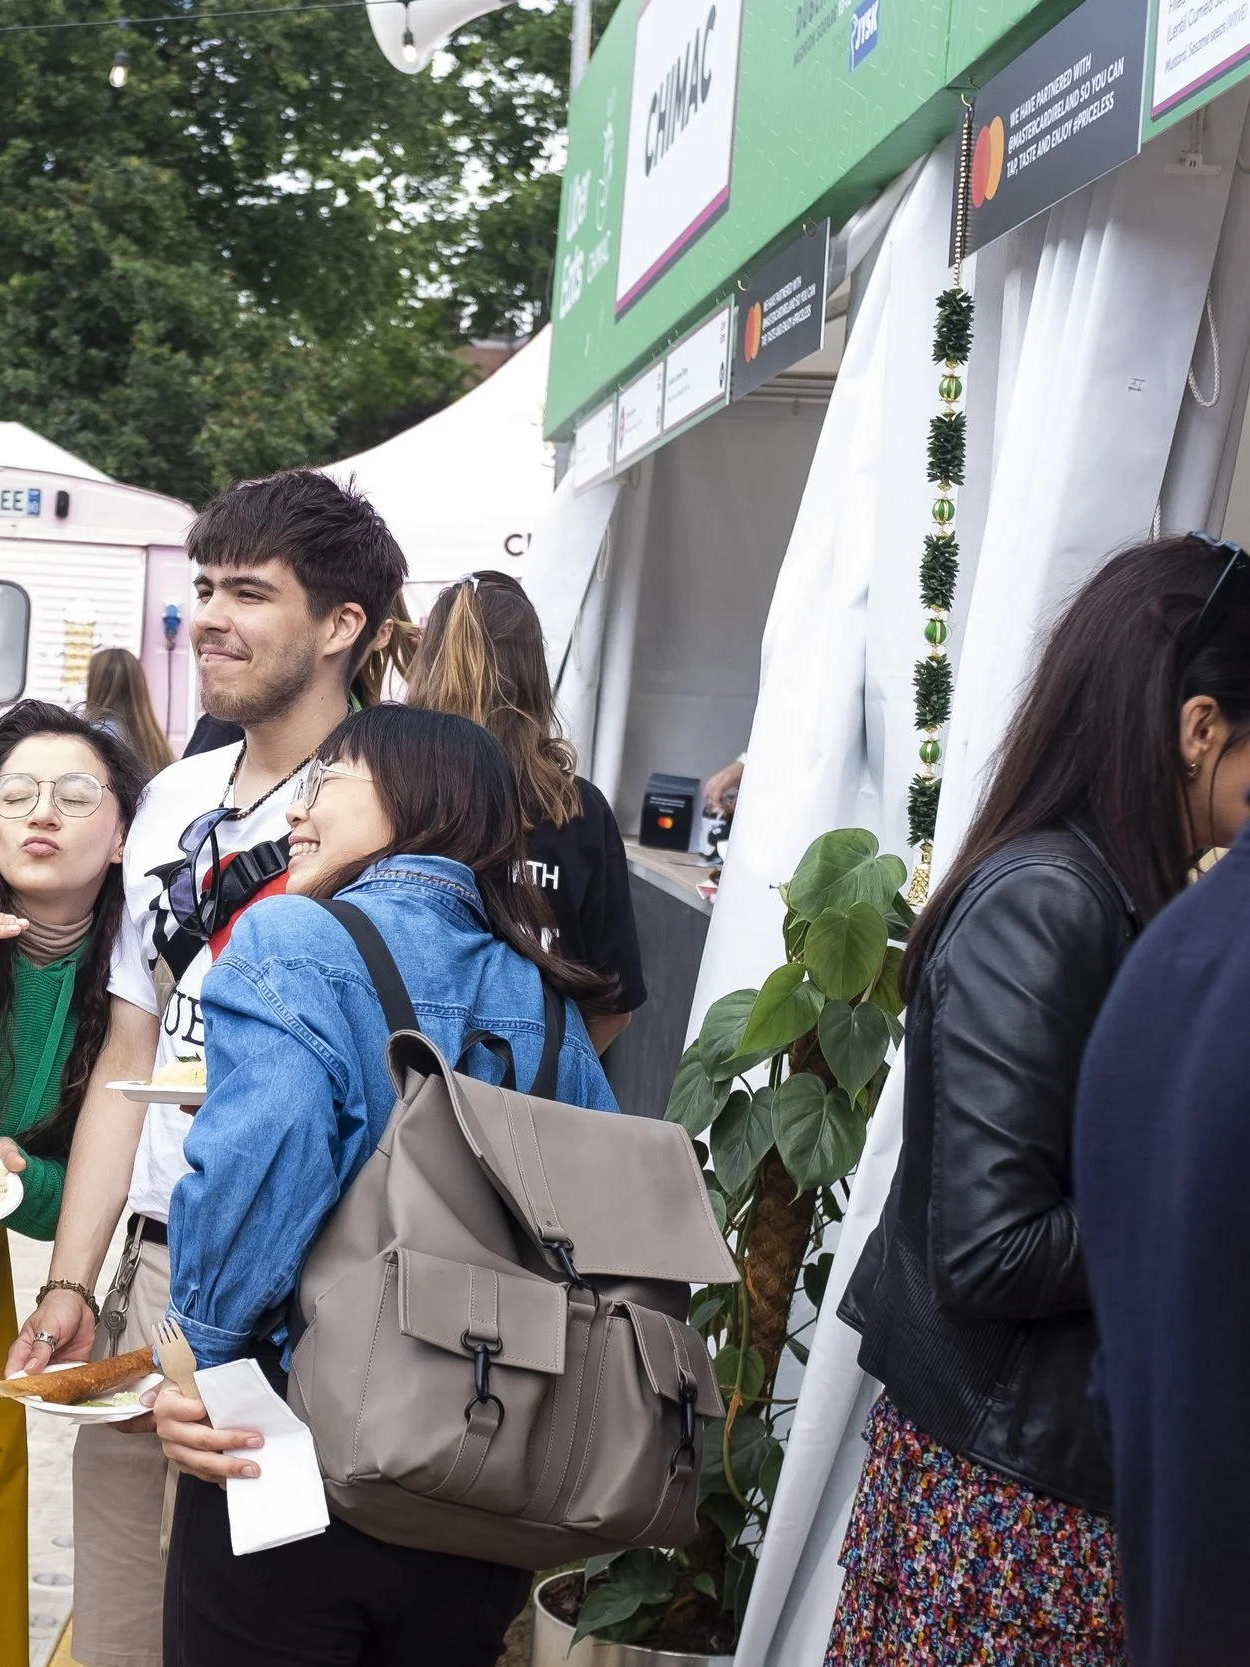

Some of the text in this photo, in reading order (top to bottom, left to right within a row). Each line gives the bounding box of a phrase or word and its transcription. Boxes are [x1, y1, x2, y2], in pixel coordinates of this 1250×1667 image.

[854, 0, 879, 50] JYSK
[645, 4, 717, 178] CHIMAC
[1010, 52, 1092, 128] WE HAVE PARTNERED WITH
[1080, 80, 1091, 103] SO
[1091, 68, 1107, 95] YOU
[1107, 56, 1125, 83] CAN
[1006, 90, 1115, 179] TAP, TASTE AND ENJOY #PRICELESS
